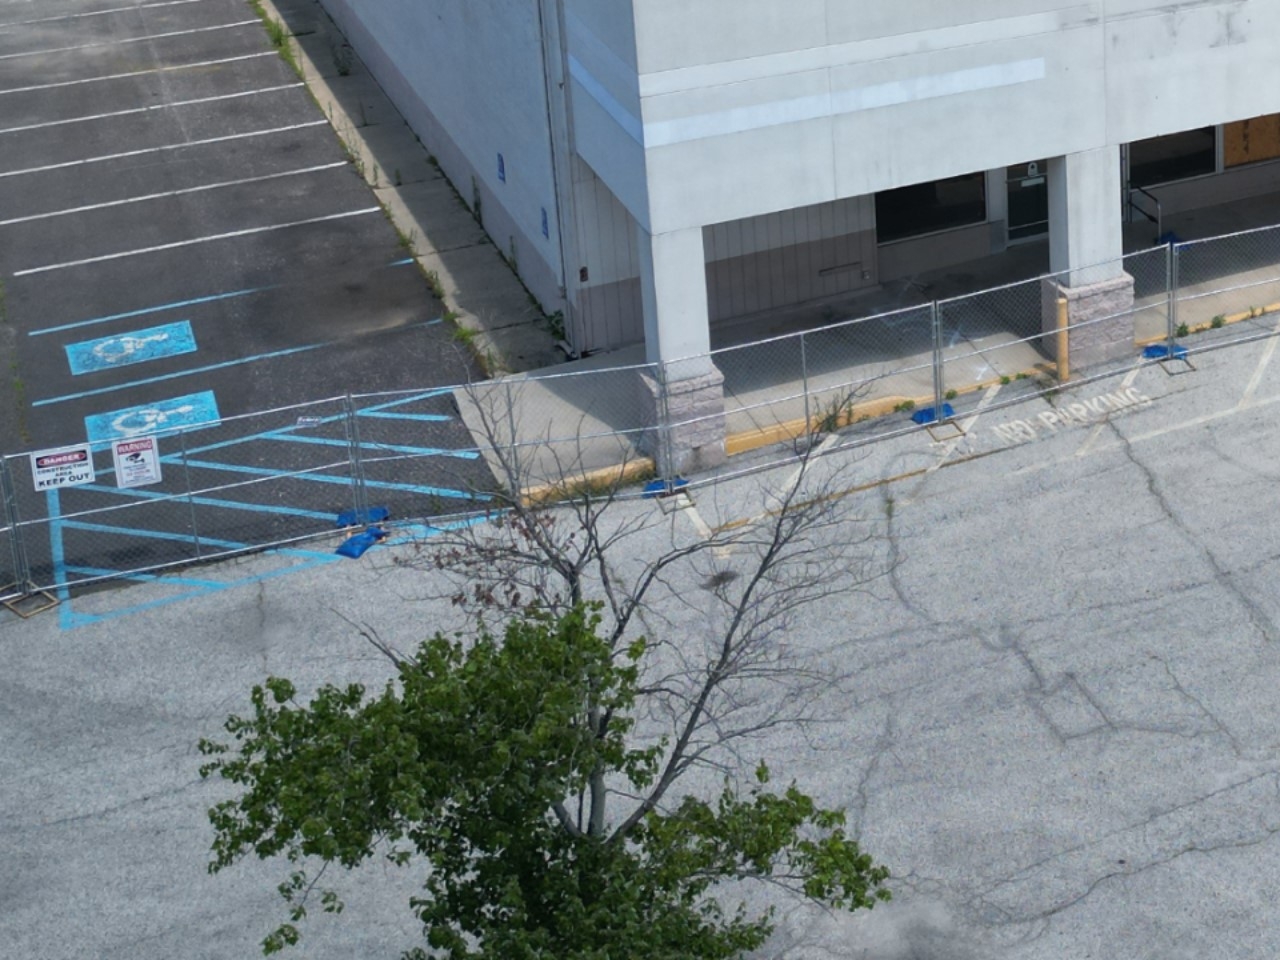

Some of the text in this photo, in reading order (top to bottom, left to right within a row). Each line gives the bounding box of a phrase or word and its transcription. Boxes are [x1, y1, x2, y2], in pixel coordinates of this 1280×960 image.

[1038, 387, 1151, 433] PARKING
[38, 473, 90, 487] KEEP OUT
